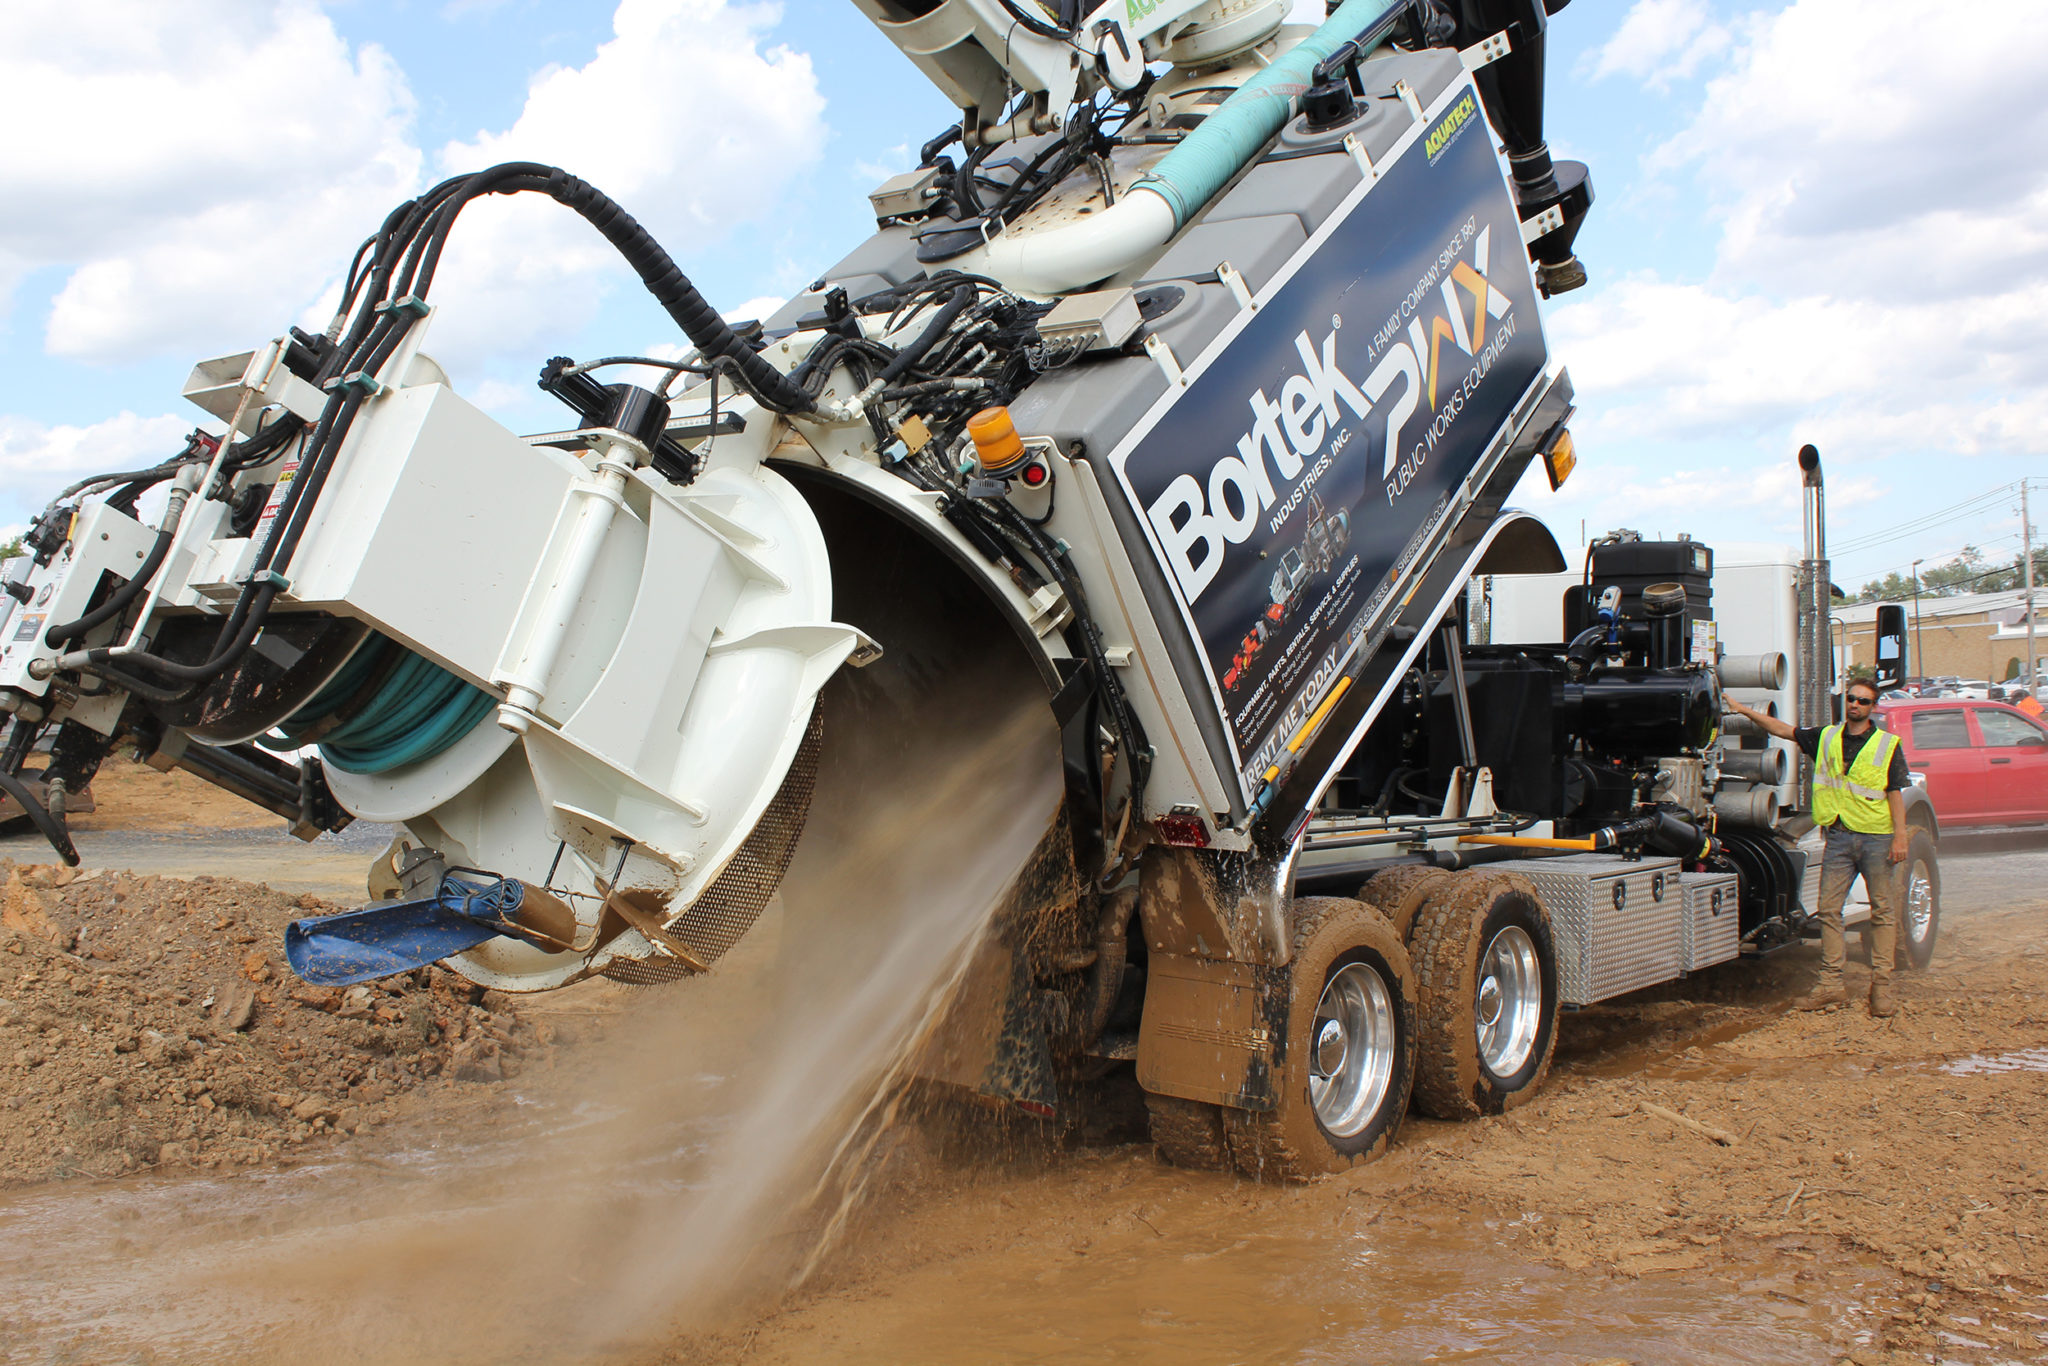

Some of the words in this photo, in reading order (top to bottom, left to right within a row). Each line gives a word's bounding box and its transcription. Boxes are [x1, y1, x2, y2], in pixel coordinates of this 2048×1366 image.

[1425, 94, 1475, 159] AQUATECH
[1360, 223, 1512, 481] PWX
[1367, 344, 1377, 362] A
[1373, 309, 1401, 352] FAMILY
[1401, 260, 1441, 317] COMPANY
[1439, 234, 1464, 270] SINCE
[1460, 215, 1477, 242] 1967
[1269, 453, 1333, 534] INDUSTRIES,
[1330, 430, 1352, 457] INC.
[1386, 442, 1426, 507] PUBLIC
[1425, 389, 1464, 451] WORKS
[1462, 312, 1517, 400] EQUIPMENT
[1397, 499, 1448, 574] SWEEPERLAND.COM
[1235, 681, 1269, 728] EQUIPMENT,
[1267, 656, 1287, 682] PARTS,
[1285, 623, 1311, 657] RENTALS,
[1331, 584, 1337, 595] &
[1335, 554, 1359, 589] SUPPLIES
[1245, 734, 1278, 790] RENT
[1278, 709, 1300, 744] ME
[1298, 647, 1338, 711] TODAY
